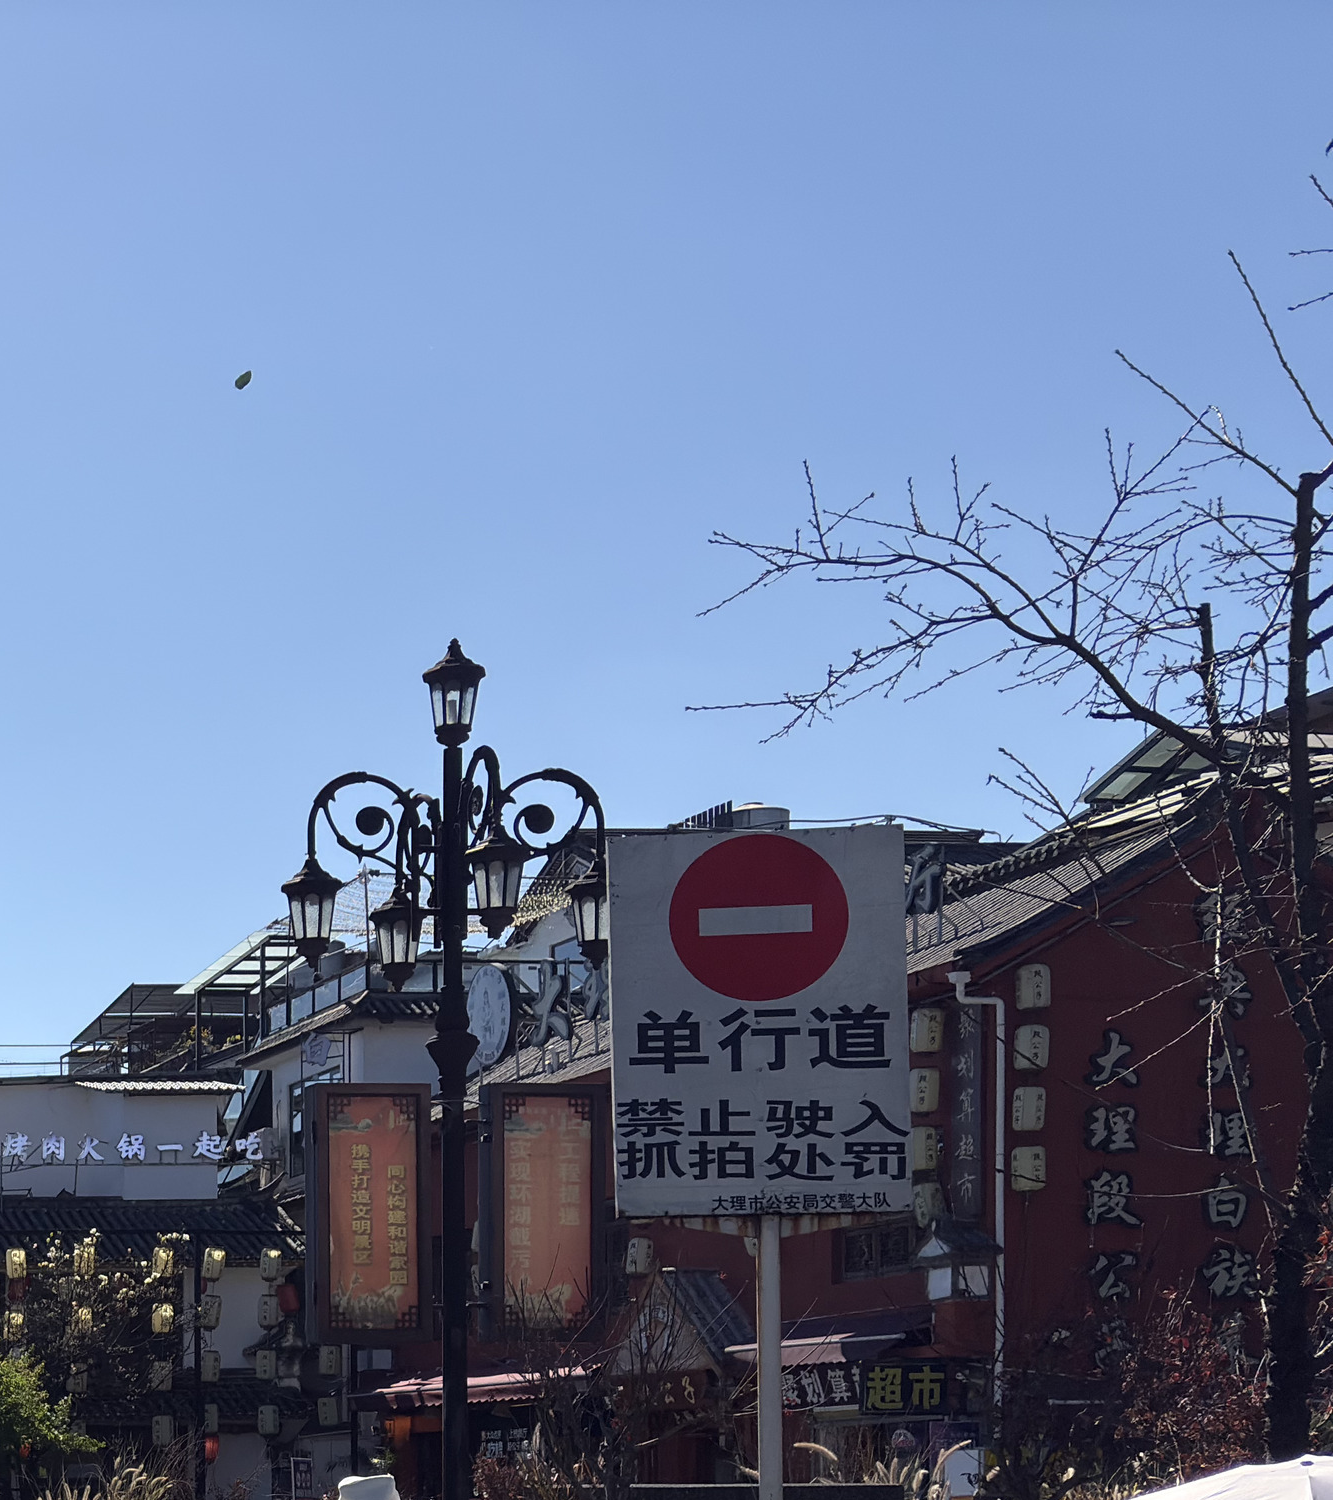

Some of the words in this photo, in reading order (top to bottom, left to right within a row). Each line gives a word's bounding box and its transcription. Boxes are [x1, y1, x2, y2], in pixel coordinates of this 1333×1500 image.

[629, 1003, 891, 1074] 单行道
[617, 1098, 909, 1139] 禁止驶入
[1, 1129, 264, 1162] 烤肉火锅一起吃
[618, 1140, 907, 1181] 抓拍处罚
[351, 1144, 373, 1266] 携手打造文明景区
[712, 1192, 891, 1213] 大理市公安局交警大队
[388, 1164, 408, 1286] 同心构建和谐家园
[866, 1366, 946, 1410] 超市
